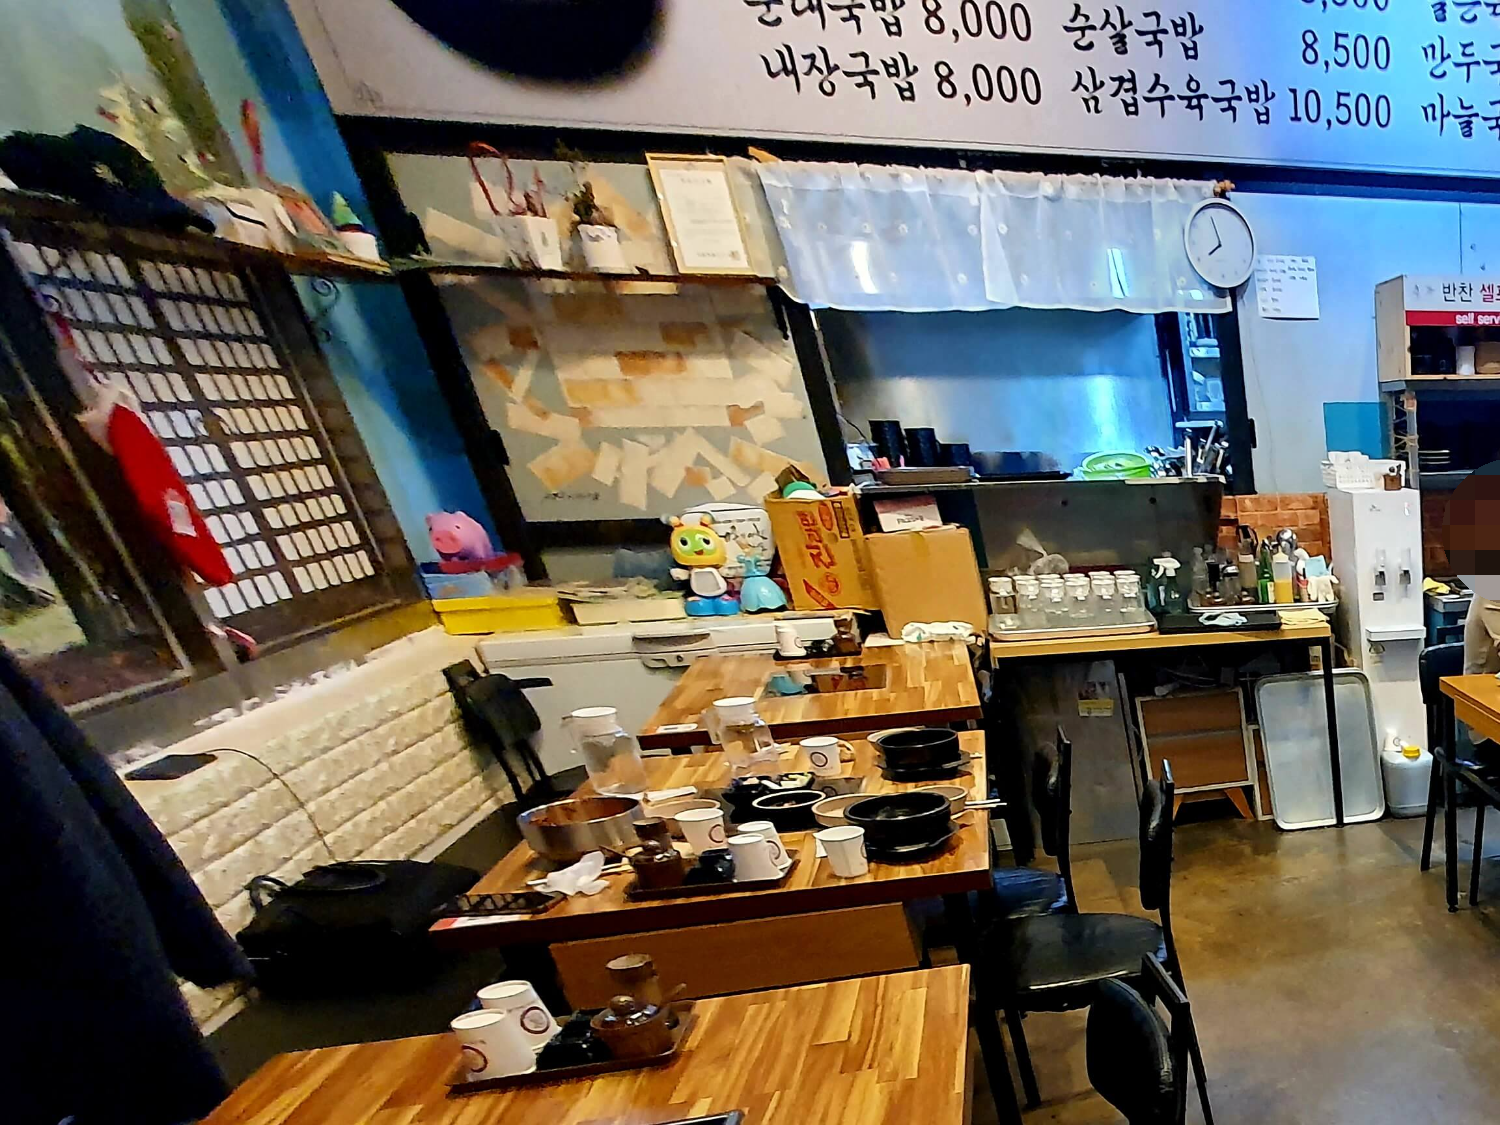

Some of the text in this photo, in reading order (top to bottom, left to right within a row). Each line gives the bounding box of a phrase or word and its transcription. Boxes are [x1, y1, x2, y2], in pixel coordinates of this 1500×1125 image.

[922, 0, 1032, 43] 8,000
[1062, 3, 1391, 73] 순살국밥 8,500
[760, 43, 1042, 106] 내장국밥 8,000
[1071, 66, 1391, 130] 삼겹수육국밥 10,500
[1442, 282, 1473, 302] 반찬
[1455, 313, 1474, 325] self
[797, 510, 837, 569] 진라면
